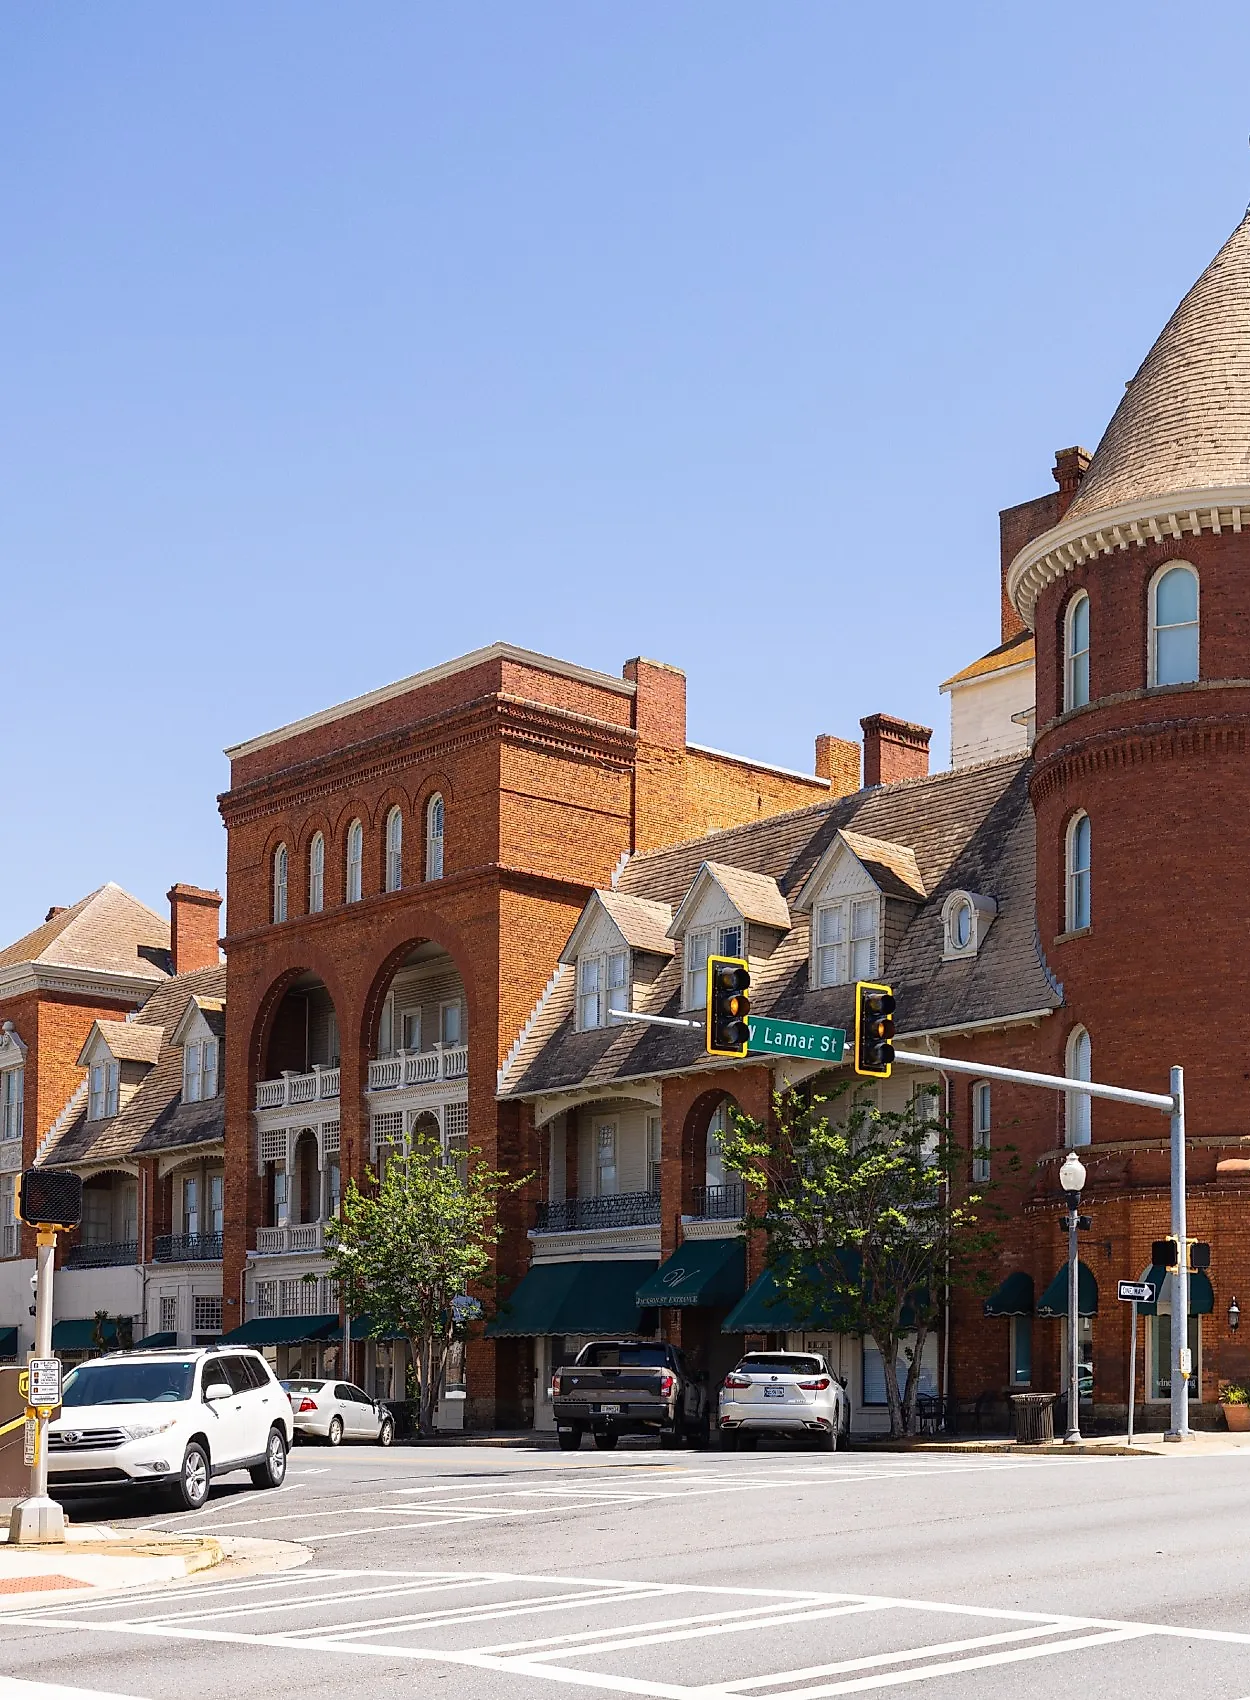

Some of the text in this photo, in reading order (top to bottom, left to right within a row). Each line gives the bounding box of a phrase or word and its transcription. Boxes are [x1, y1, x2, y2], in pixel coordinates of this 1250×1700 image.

[764, 1027, 815, 1050] Lamar
[820, 1035, 838, 1053] St
[1122, 1286, 1145, 1295] ONE WAY
